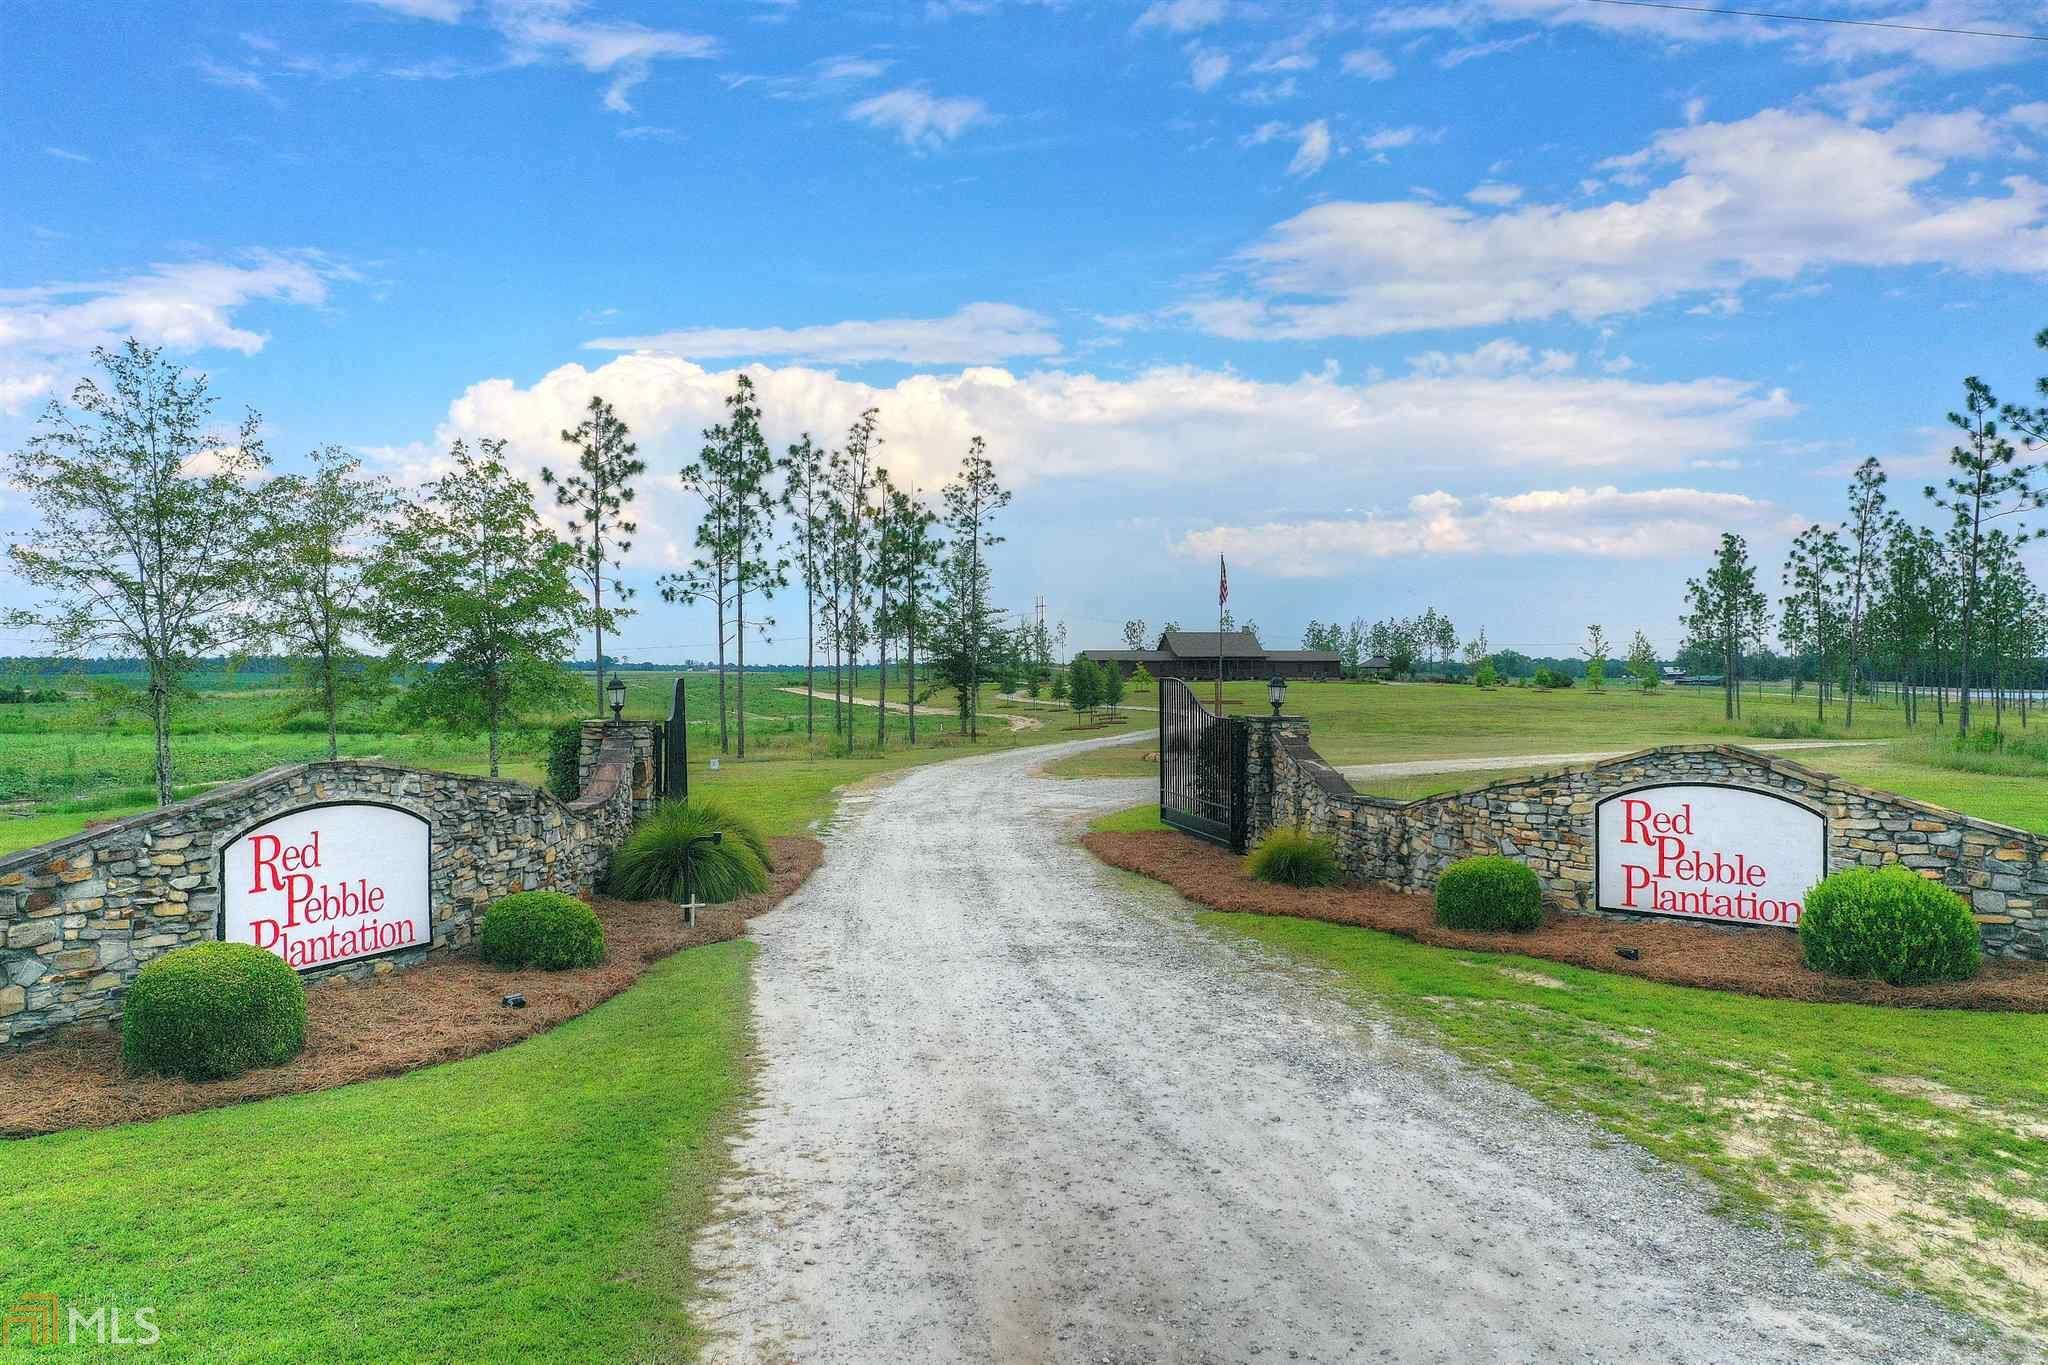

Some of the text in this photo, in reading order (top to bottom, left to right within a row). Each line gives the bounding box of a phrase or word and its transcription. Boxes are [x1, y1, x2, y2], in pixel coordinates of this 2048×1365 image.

[1620, 799, 1694, 846] Red
[248, 831, 322, 894] Red
[1652, 835, 1766, 887] Pebble
[281, 873, 385, 928] Pebble
[1620, 864, 1803, 924] Plantation
